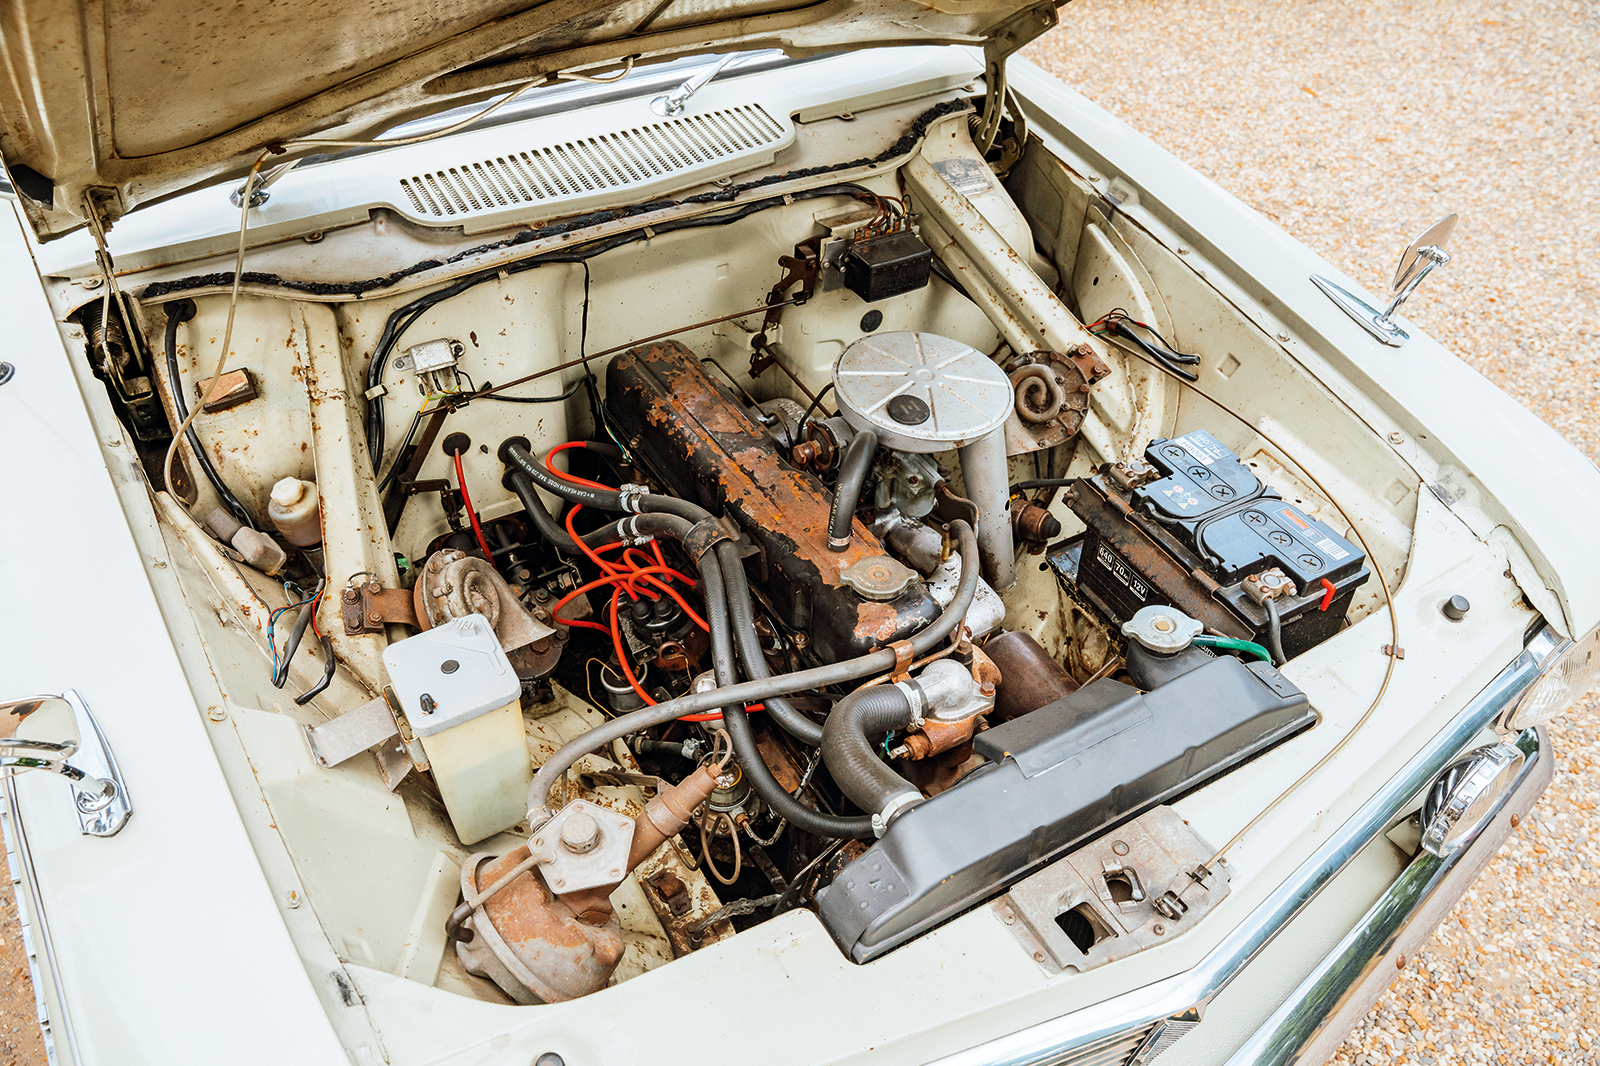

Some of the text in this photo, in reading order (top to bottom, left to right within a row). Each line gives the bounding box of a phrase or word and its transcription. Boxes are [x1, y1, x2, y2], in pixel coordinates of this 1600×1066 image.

[546, 478, 560, 489] HOSE
[559, 484, 577, 494] HEATER
[1099, 547, 1113, 563] 640
[1133, 580, 1146, 595] 12V
